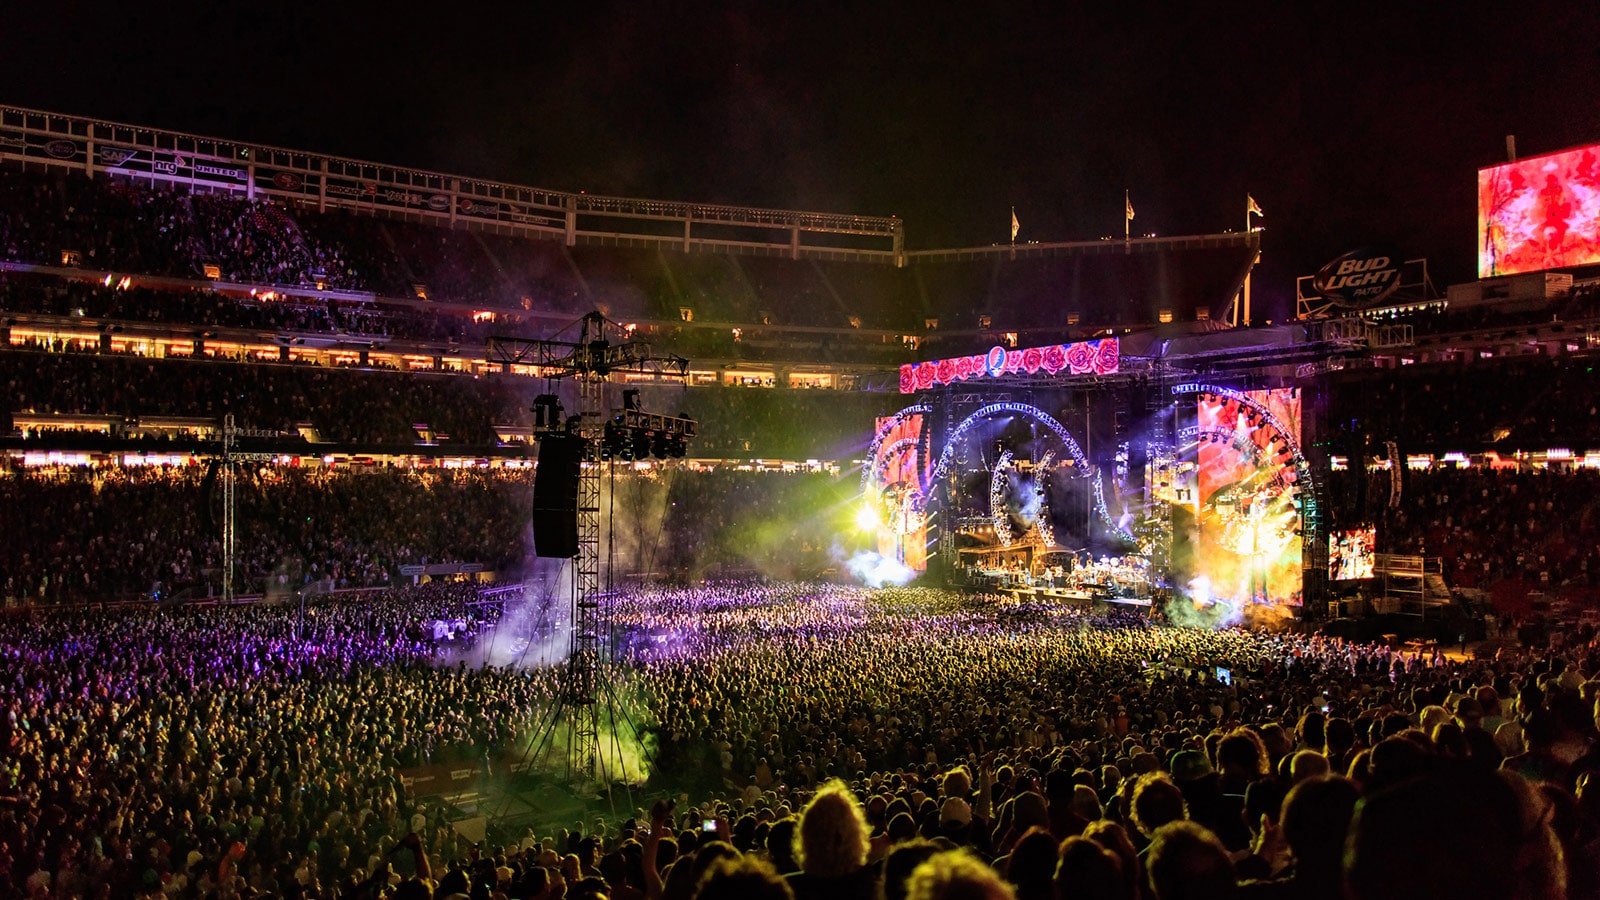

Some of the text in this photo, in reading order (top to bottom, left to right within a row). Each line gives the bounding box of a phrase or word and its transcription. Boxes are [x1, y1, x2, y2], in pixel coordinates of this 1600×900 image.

[101, 150, 127, 162] SAP
[155, 160, 178, 175] nrg
[195, 165, 236, 176] UNITED
[327, 184, 365, 197] BROCADE
[1336, 256, 1390, 275] BUD
[1324, 268, 1397, 291] LIGHT
[1353, 285, 1383, 297] PATIO
